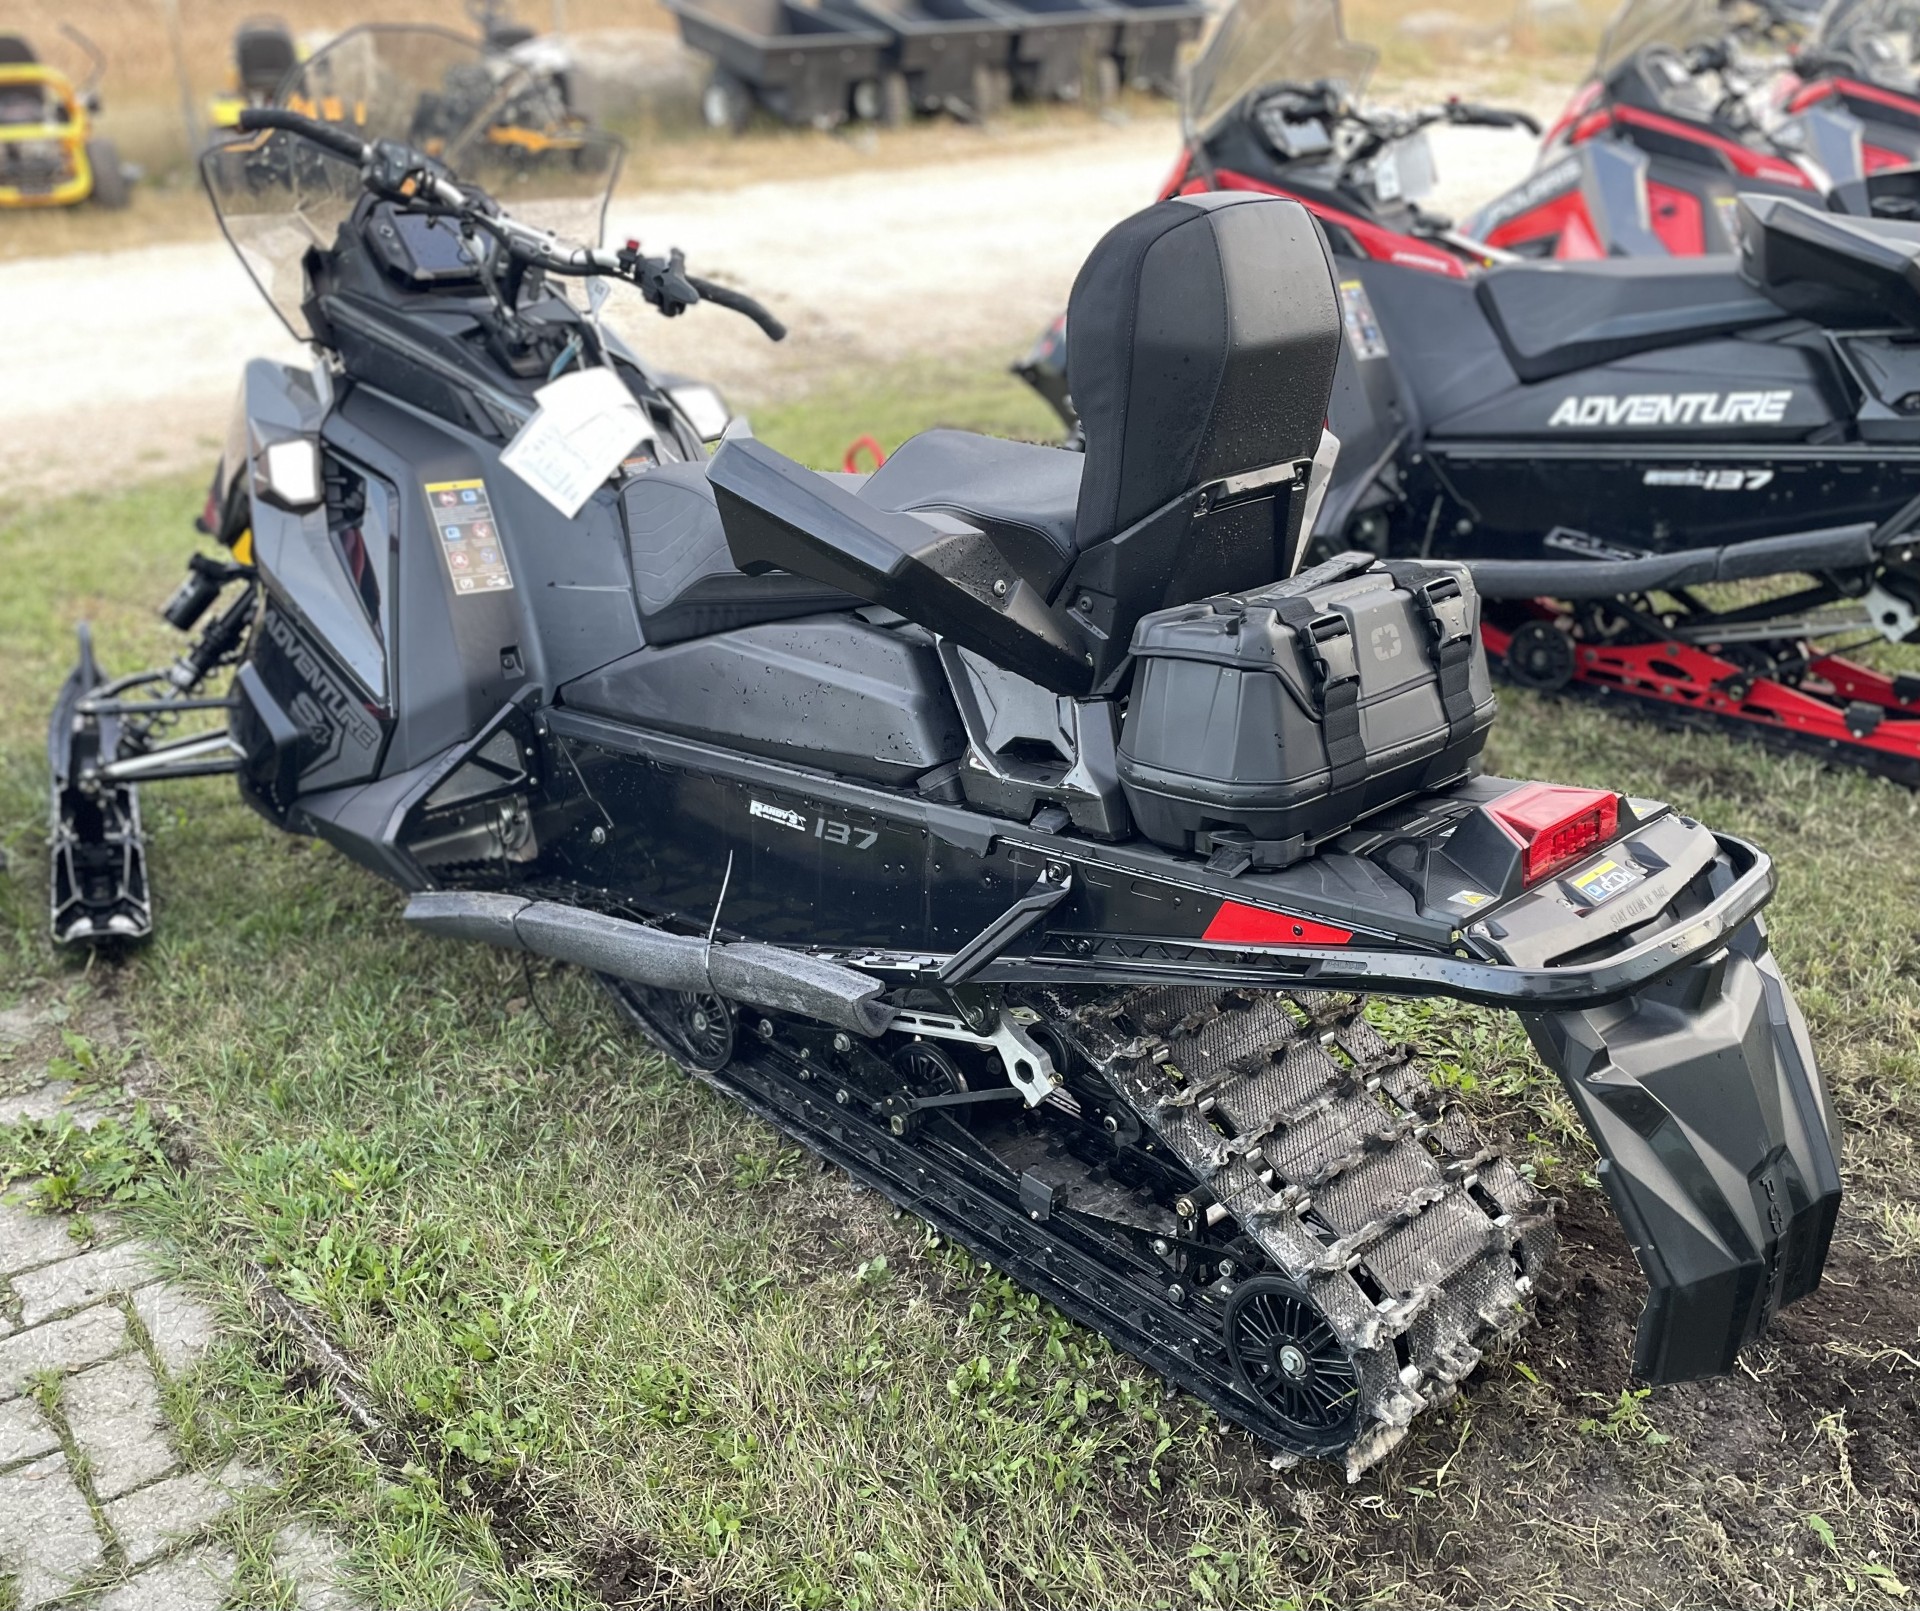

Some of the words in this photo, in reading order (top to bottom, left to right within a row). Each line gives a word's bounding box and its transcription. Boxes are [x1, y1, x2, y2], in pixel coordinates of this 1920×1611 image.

[1547, 391, 1793, 426] ADVENTURE
[1702, 469, 1774, 491] 137
[265, 610, 379, 750] ADVENTURE
[814, 817, 879, 850] 137
[1611, 909, 1628, 928] STAY
